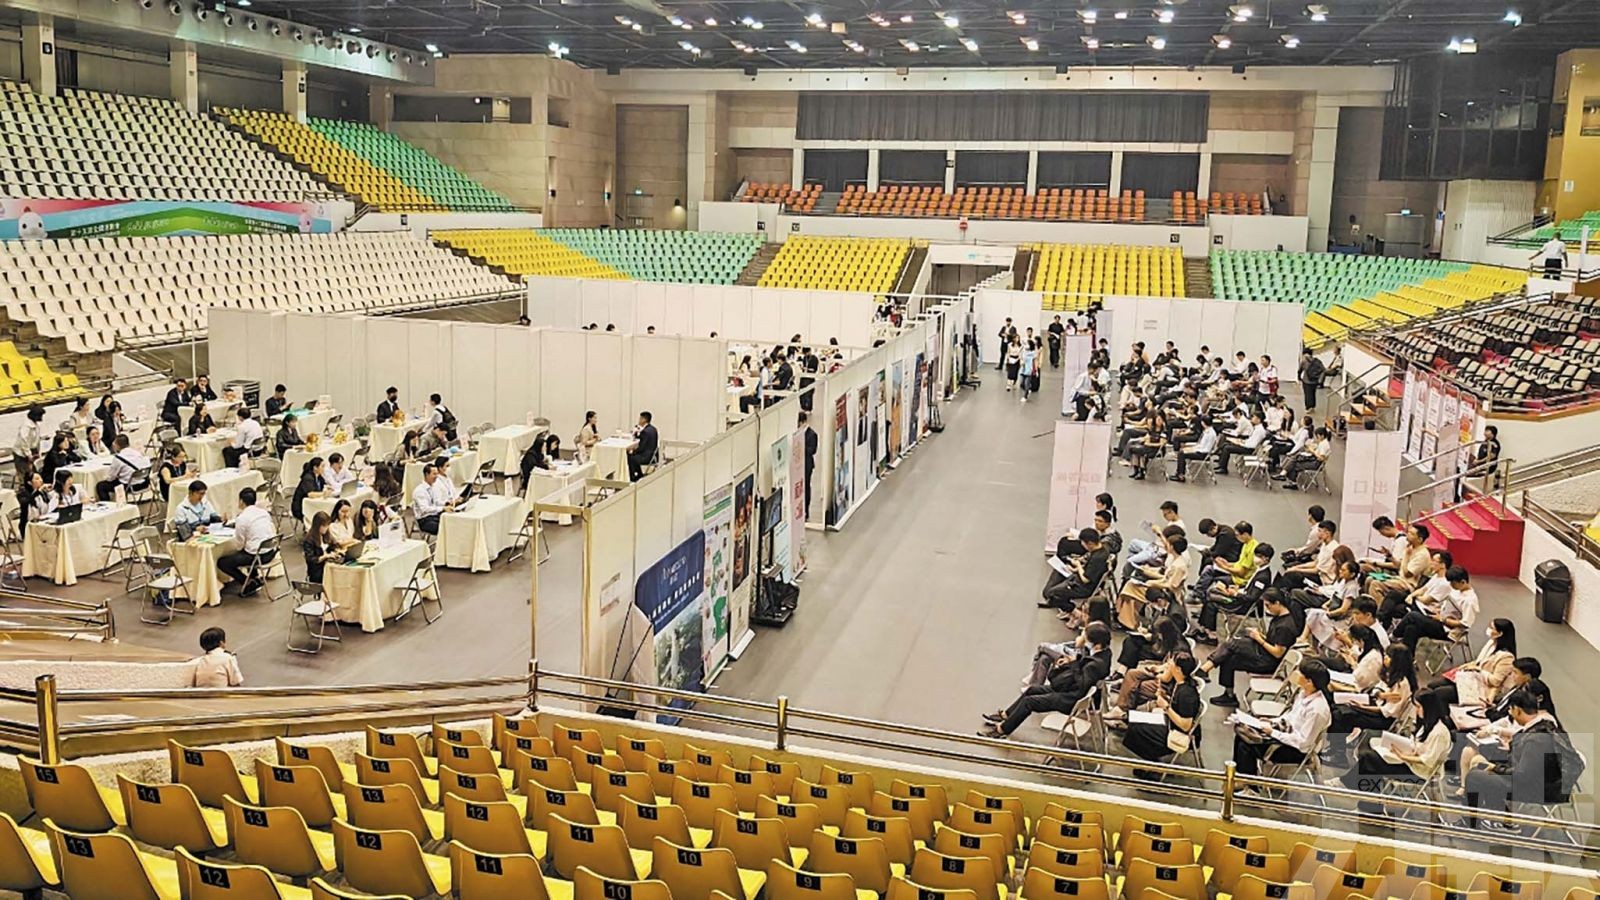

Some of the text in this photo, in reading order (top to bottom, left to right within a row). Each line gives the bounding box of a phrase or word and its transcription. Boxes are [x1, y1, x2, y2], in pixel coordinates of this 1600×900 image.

[381, 735, 392, 745] 15
[455, 748, 466, 757] 14
[187, 753, 200, 764] 15
[374, 761, 387, 771] 14
[533, 760, 545, 770] 13
[38, 768, 54, 780] 15
[276, 770, 290, 781] 14
[461, 777, 474, 788] 13
[612, 776, 624, 786] 12
[140, 788, 156, 801] 14
[366, 791, 380, 801] 13
[549, 794, 562, 804] 12
[470, 807, 484, 819] 12
[642, 808, 654, 817] 11
[780, 806, 792, 815] 10
[246, 811, 263, 825] 13
[574, 828, 588, 840] 11
[69, 839, 88, 855] 13
[360, 835, 377, 848] 12
[682, 852, 697, 864] 10
[480, 858, 497, 872] 11
[203, 869, 224, 886] 12
[608, 885, 626, 900] 10
